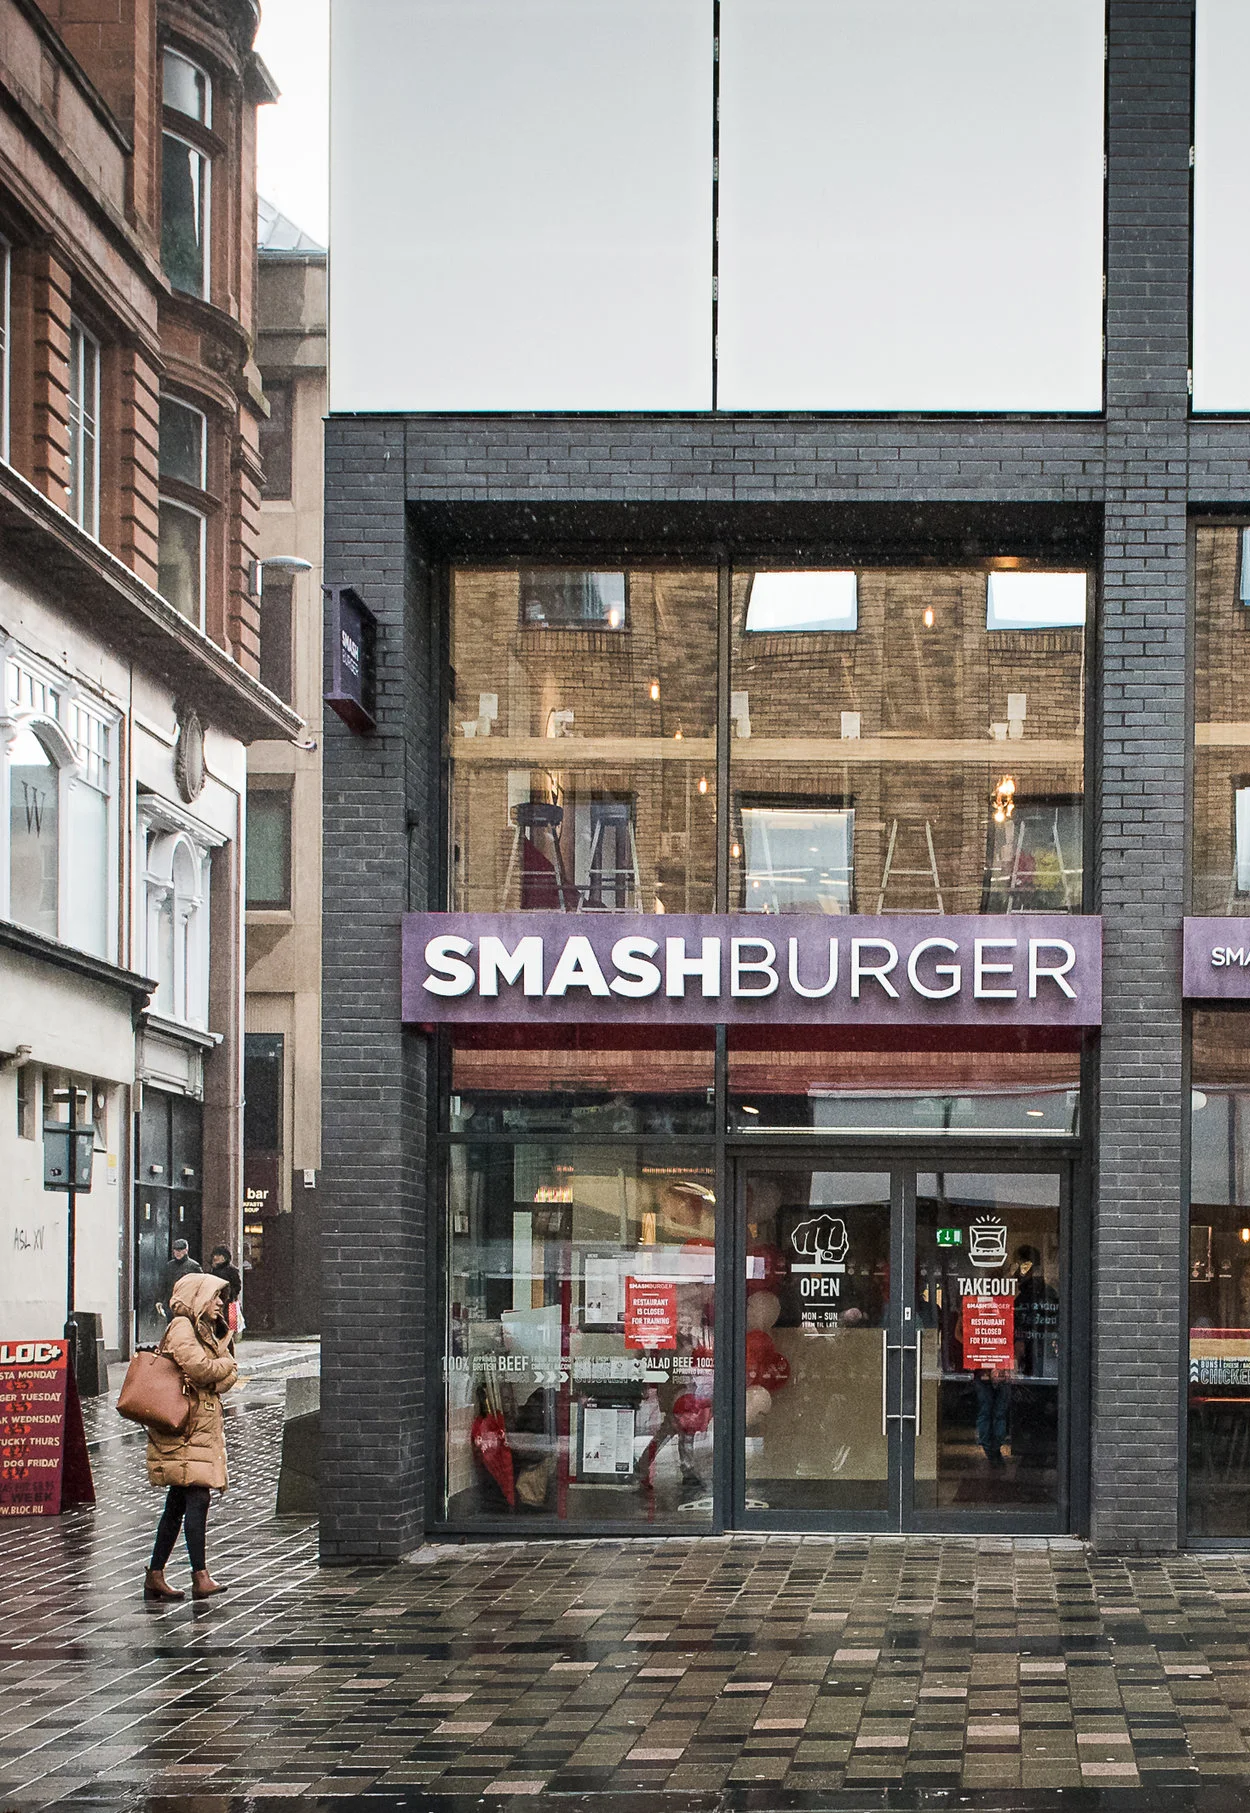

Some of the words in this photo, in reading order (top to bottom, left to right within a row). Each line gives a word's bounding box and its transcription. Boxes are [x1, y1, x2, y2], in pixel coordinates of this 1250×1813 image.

[341, 629, 359, 662] SMASH
[422, 934, 1078, 1001] SMASHBURGER
[246, 1187, 269, 1199] bar
[800, 1277, 840, 1297] OPEN
[957, 1277, 1018, 1296] TAKEOUT
[632, 1298, 669, 1306] RESTAURANT
[631, 1317, 643, 1325] FOR
[643, 1317, 670, 1325] TRAINING
[801, 1311, 817, 1321] MON
[824, 1311, 838, 1321] SUN
[970, 1318, 1006, 1326] RESTAURANT
[969, 1337, 981, 1345] FOR
[981, 1337, 1007, 1345] TRAINING
[498, 1355, 529, 1371] BEEF
[641, 1356, 670, 1369] SALAD
[672, 1356, 694, 1368] BEEF
[1200, 1360, 1218, 1368] BUNS
[18, 1370, 58, 1379] MONDAY
[21, 1392, 62, 1401] TUESDAY
[11, 1414, 62, 1424] WEDNSDAY
[29, 1436, 60, 1446] THURS
[3, 1459, 25, 1468] DOG
[27, 1458, 60, 1468] FRIDAY
